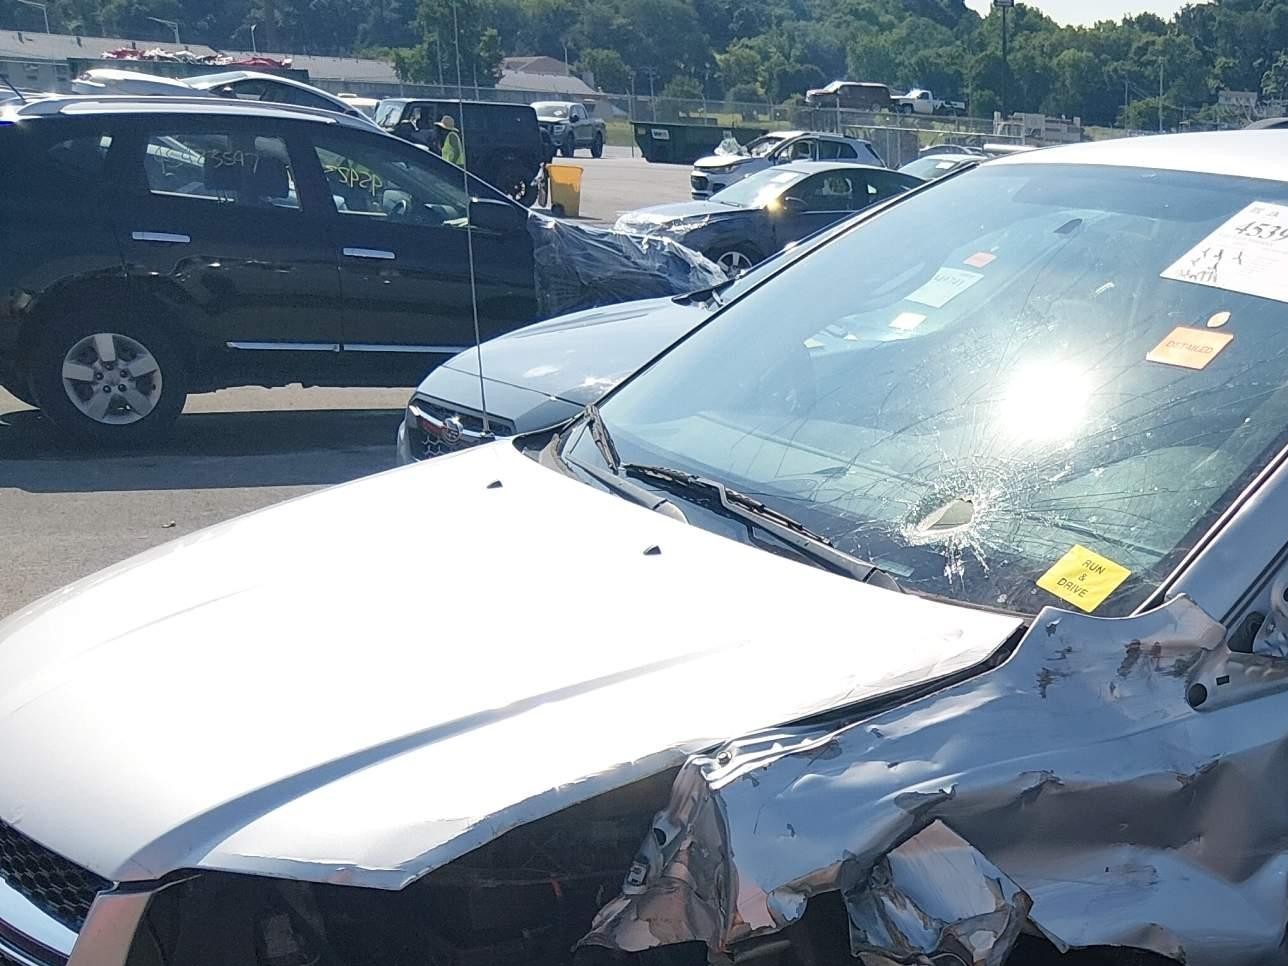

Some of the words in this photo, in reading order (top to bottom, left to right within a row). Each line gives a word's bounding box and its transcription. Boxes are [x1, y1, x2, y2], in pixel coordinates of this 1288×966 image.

[1081, 559, 1106, 575] RUN
[1078, 573, 1088, 581] &
[1056, 577, 1089, 598] DRIVE
